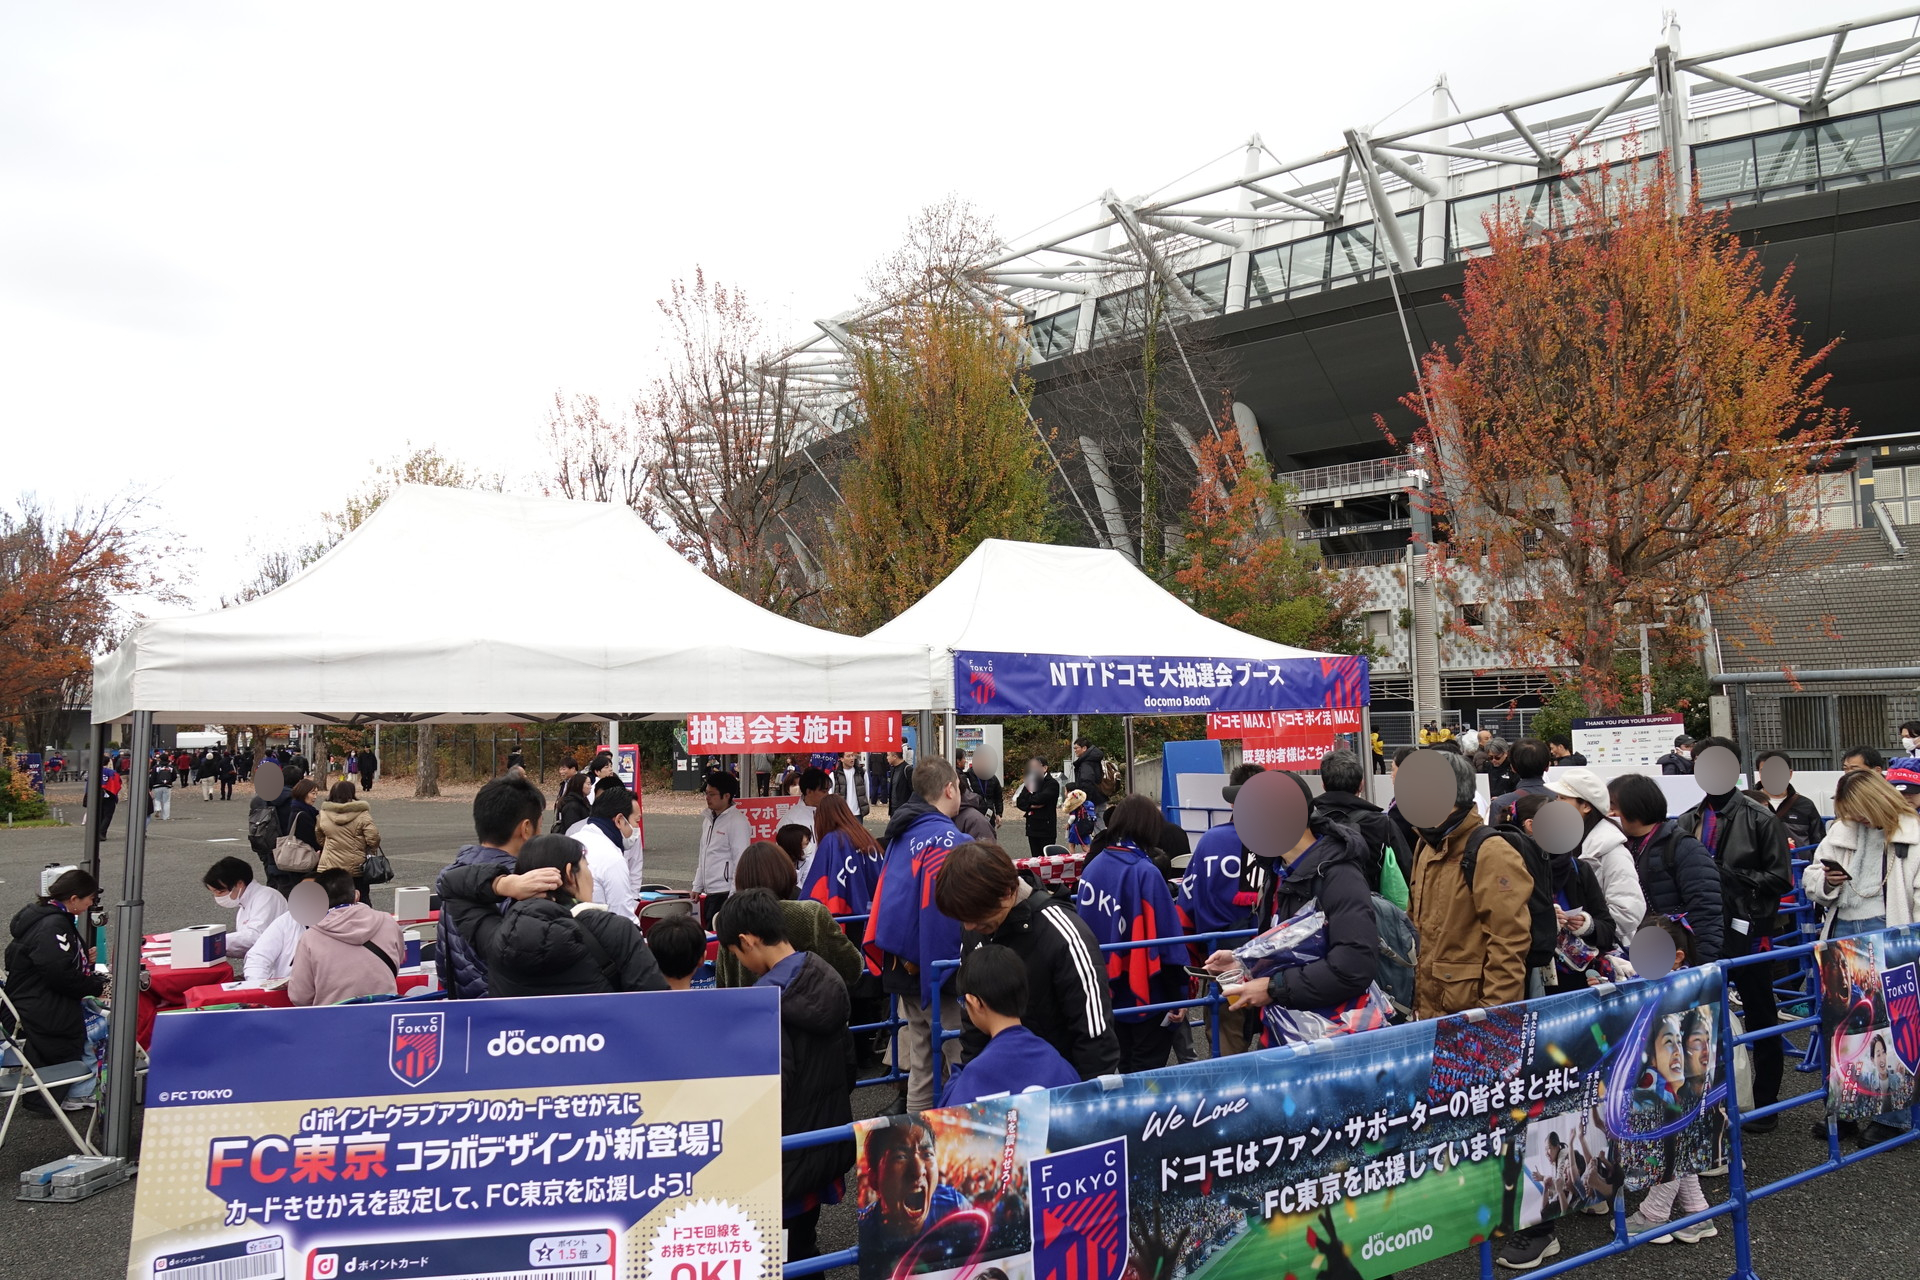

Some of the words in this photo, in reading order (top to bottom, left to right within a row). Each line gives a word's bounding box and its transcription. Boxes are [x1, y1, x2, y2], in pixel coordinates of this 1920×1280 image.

[1144, 695, 1181, 707] docomo
[1183, 694, 1210, 707] Booth
[910, 835, 954, 856] TOKYO
[1887, 981, 1915, 999] TOKYO
[397, 1024, 438, 1034] TOKYO
[508, 1029, 525, 1037] NTT
[487, 1030, 605, 1057] docomo
[189, 1088, 233, 1100] TOKYO
[302, 1093, 640, 1132] dポイントクラブアプリのカードきせかえに
[1142, 1110, 1185, 1142] We
[1192, 1095, 1249, 1128] Love
[1161, 1066, 1580, 1192] ドコモはファン・サポーターの皆さまと共に
[1264, 1126, 1507, 1219] FC東京を応援しています
[1041, 1169, 1118, 1203] TOKYO
[225, 1171, 692, 1225] カードきせかえを設定して、FC東京を応援しよう!
[673, 1223, 741, 1241] ドコモ回線を
[1373, 1230, 1385, 1240] NTT
[558, 1238, 587, 1247] ポイント
[661, 1239, 752, 1259] お持ちでない方も
[1361, 1224, 1433, 1261] docomo
[558, 1248, 577, 1260] 1.5
[344, 1256, 429, 1273] dポイントカード
